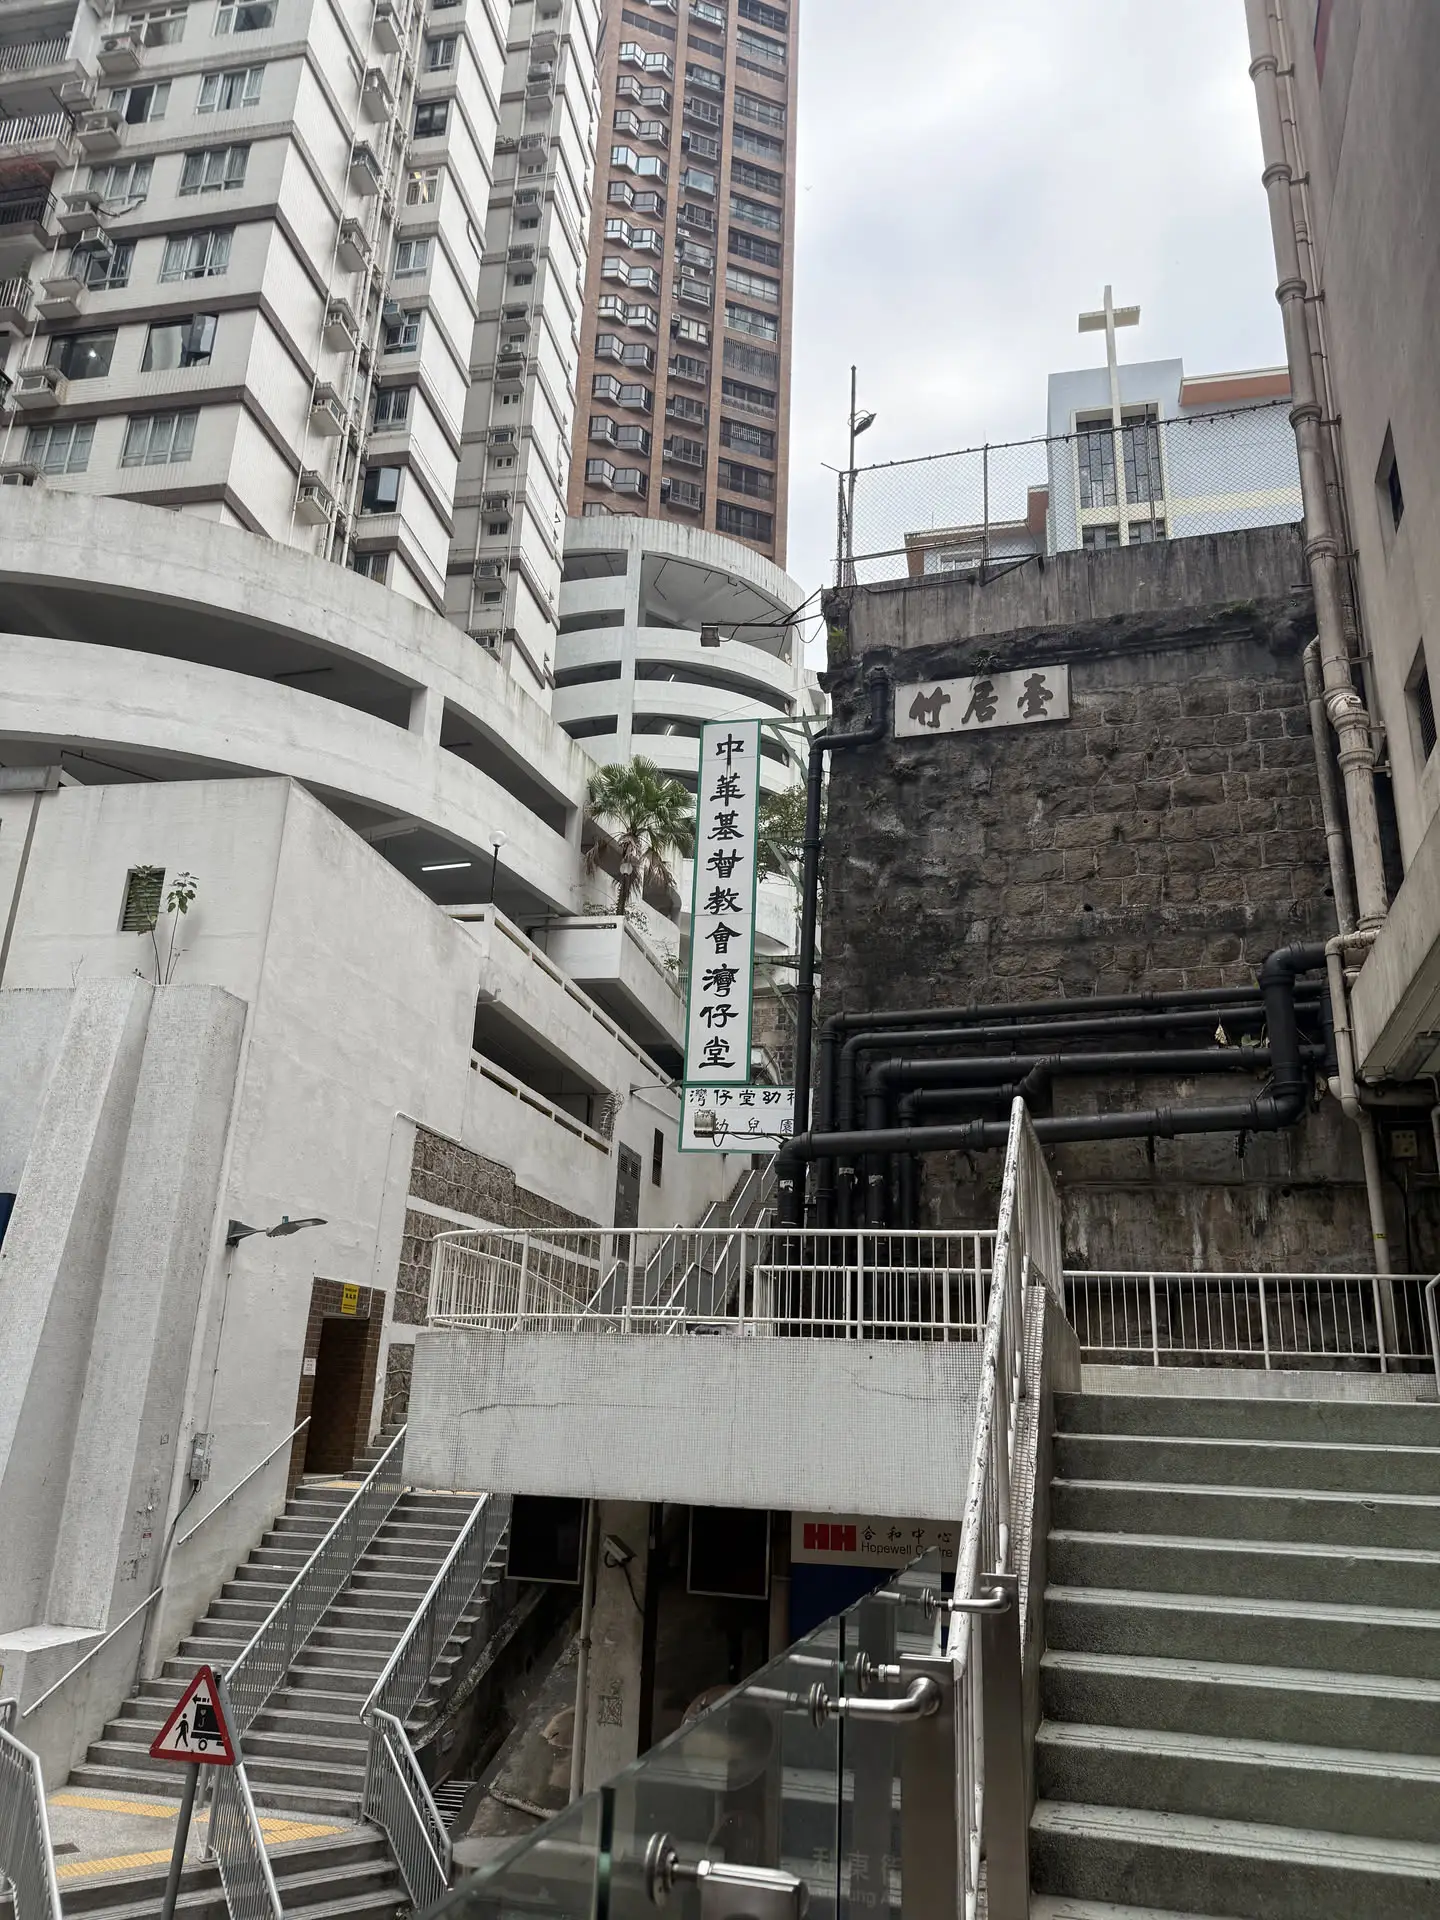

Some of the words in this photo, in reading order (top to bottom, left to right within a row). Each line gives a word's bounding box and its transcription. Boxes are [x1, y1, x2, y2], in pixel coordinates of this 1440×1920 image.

[699, 733, 745, 1069] 中華基督教會灣仔堂
[861, 1525, 952, 1545] 合和中心
[861, 1543, 912, 1555] Hopewell
